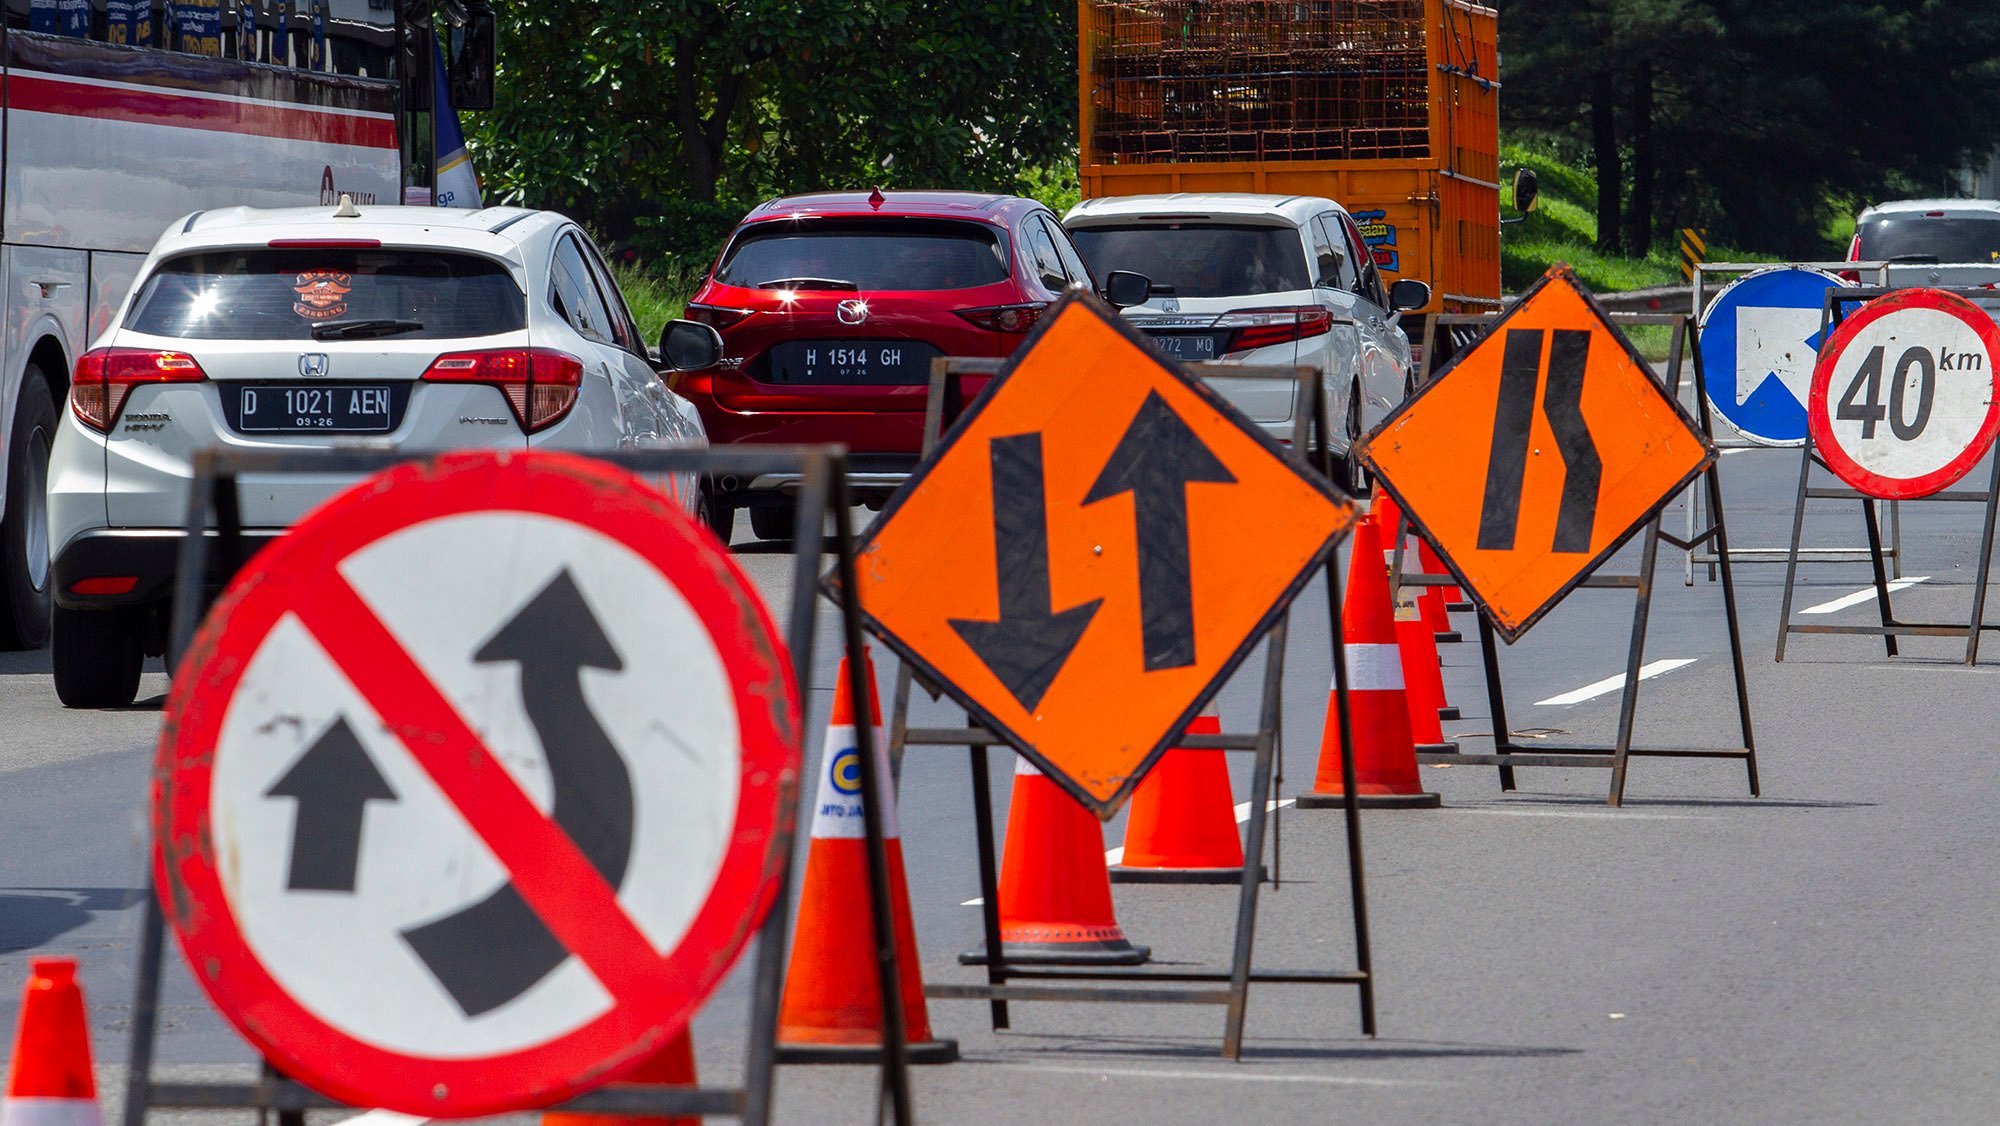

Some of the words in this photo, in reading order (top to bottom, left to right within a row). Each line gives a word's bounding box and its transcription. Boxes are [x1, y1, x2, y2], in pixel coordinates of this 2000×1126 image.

[806, 349, 816, 366] H
[828, 349, 868, 366] 1514
[880, 349, 901, 366] GH
[243, 390, 257, 415] D
[285, 390, 333, 415] 1021
[348, 390, 388, 415] AEN
[1836, 345, 1936, 442] 40
[1939, 346, 1983, 371] km
